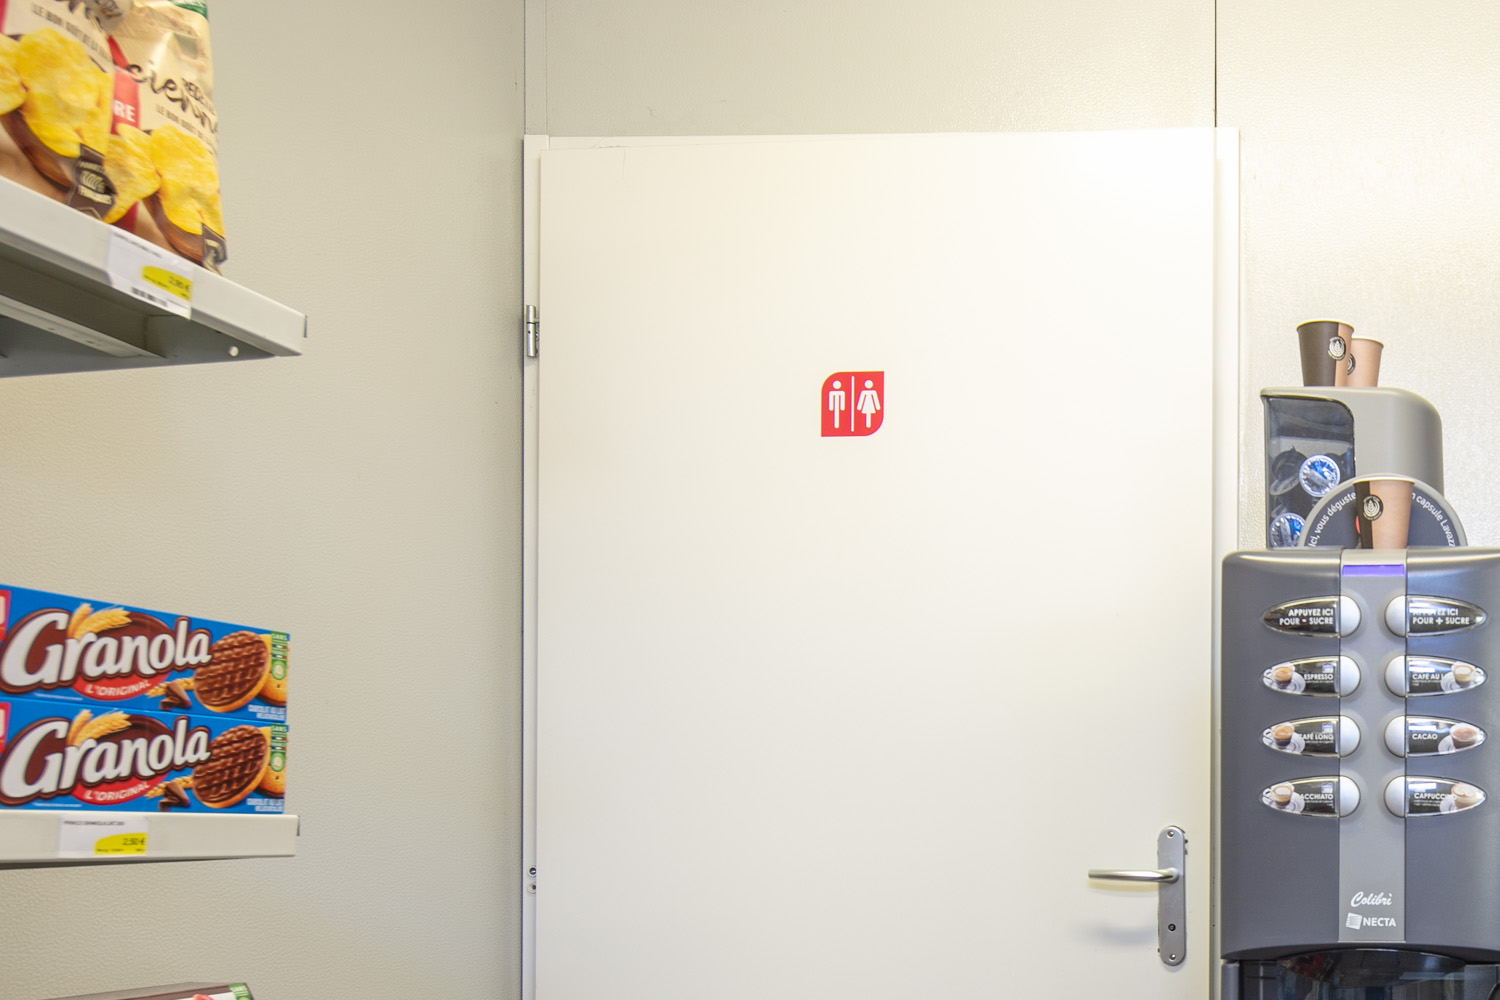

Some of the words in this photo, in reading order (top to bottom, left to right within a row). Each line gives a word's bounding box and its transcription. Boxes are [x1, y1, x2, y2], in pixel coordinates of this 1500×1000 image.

[1313, 514, 1330, 537] vous
[1327, 491, 1356, 517] déguste
[1416, 494, 1444, 522] capsule
[1439, 515, 1456, 547] Lavazz
[1288, 608, 1320, 616] APPUYEZ
[1322, 608, 1334, 616] ICI
[1447, 608, 1459, 616] ICI
[1279, 617, 1300, 625] POUR
[1309, 617, 1334, 625] SUCRE
[1412, 617, 1434, 625] POUR
[1445, 617, 1470, 625] SUCRE
[2, 611, 212, 687] Granola
[1412, 672, 1430, 680] CAFÉ
[85, 679, 152, 697] L'ORIGINAL
[1299, 732, 1314, 740] AFÉ
[1315, 733, 1334, 741] LONG
[1, 720, 211, 798] Granola
[84, 781, 152, 801] L'ORIGINAL
[1362, 917, 1397, 927] NECTA
